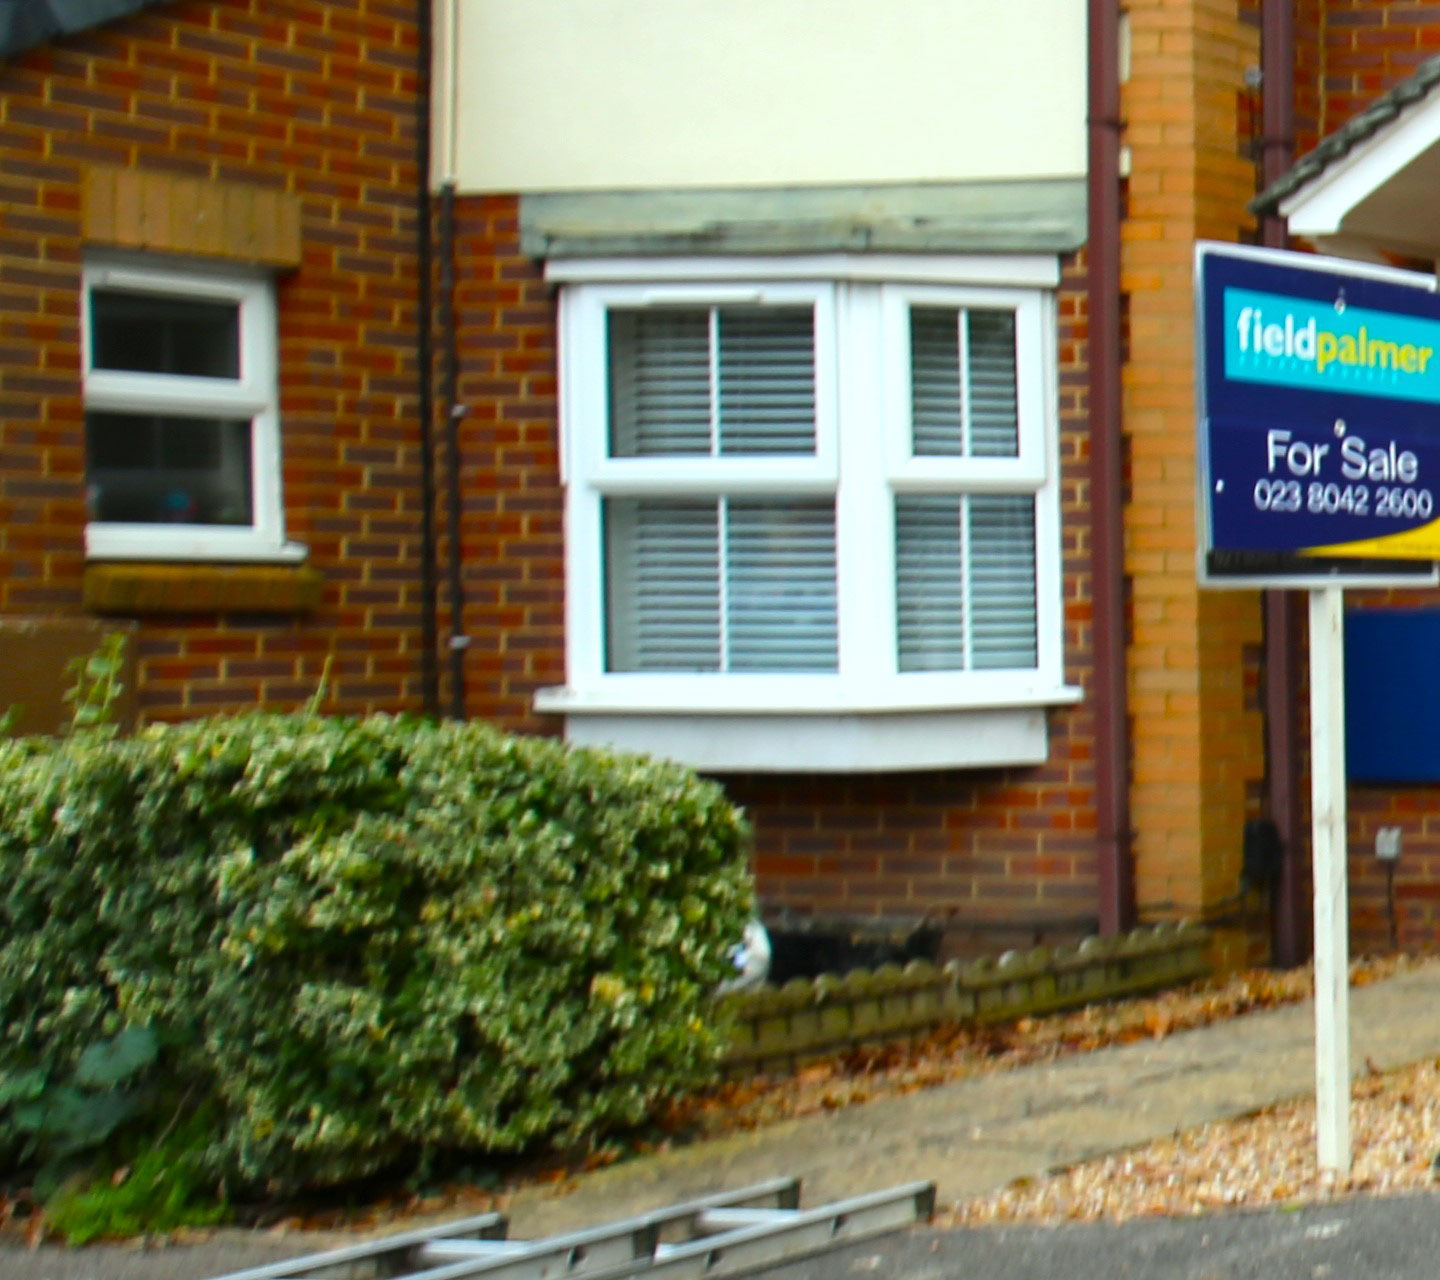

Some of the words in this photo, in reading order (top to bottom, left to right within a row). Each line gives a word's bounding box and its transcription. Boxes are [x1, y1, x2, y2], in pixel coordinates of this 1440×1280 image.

[1237, 306, 1434, 374] fieldpalmer
[1267, 429, 1330, 477] For
[1341, 435, 1418, 484] Sale
[1254, 478, 1302, 512] 023
[1307, 481, 1369, 516] 8042
[1374, 486, 1433, 519] 2600
